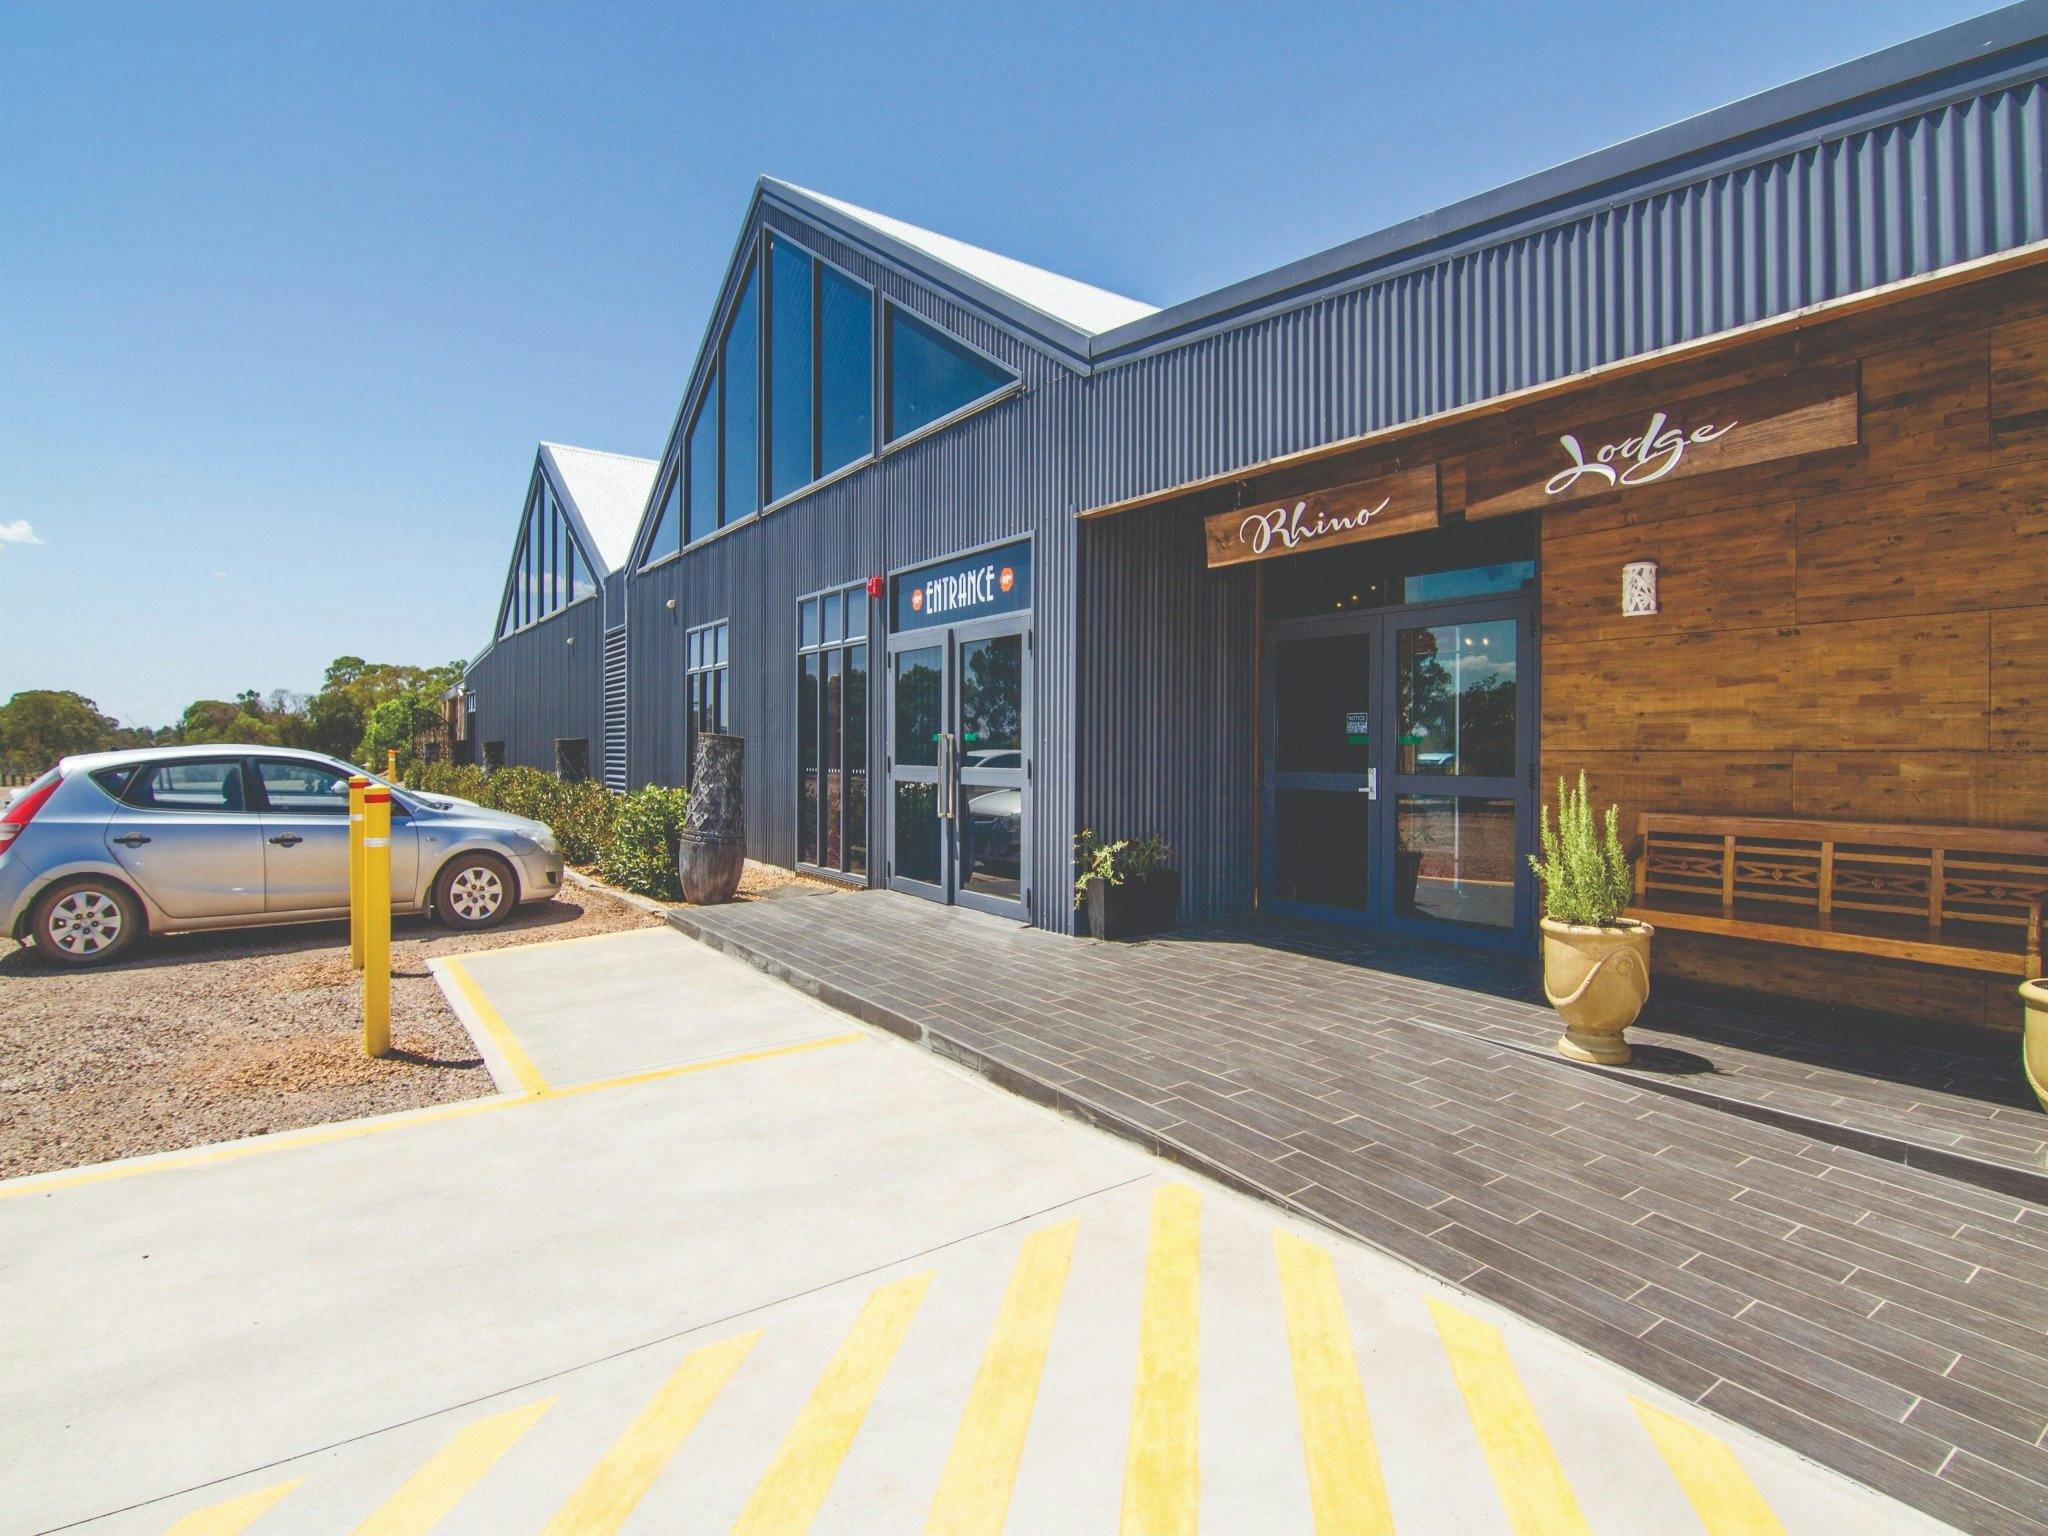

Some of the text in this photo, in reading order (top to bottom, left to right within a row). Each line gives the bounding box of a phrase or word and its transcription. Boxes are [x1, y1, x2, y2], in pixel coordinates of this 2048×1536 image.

[1240, 413, 1738, 554] Rhino Lodge
[926, 565, 995, 614] ENTRANCE
